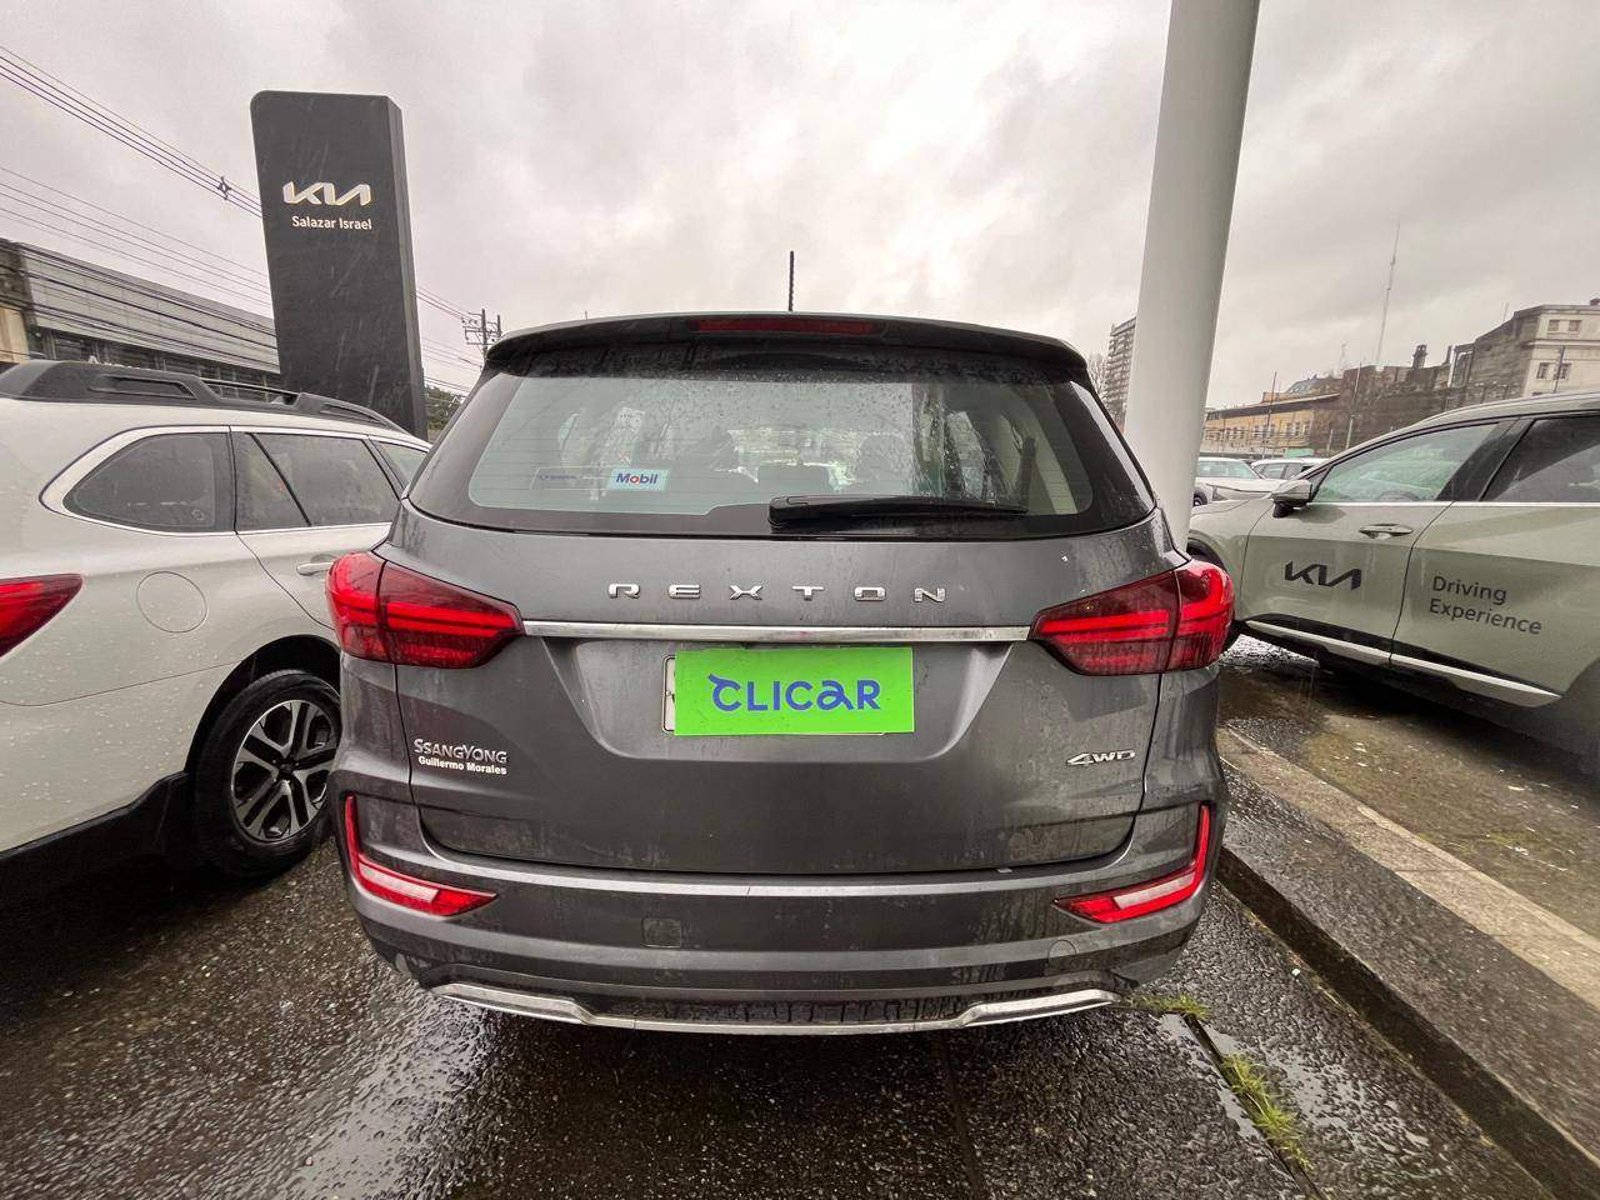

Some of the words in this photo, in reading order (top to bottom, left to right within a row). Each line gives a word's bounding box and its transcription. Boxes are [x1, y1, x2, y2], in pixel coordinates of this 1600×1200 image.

[292, 215, 336, 229] Salazar
[339, 217, 372, 230] Israel
[615, 473, 659, 485] Mobil
[608, 583, 947, 602] REXTON
[1433, 575, 1507, 605] Driving
[1429, 598, 1542, 635] Experience
[418, 755, 465, 771] Guillermo
[466, 762, 508, 775] Morales
[1066, 749, 1136, 766] 4WD
